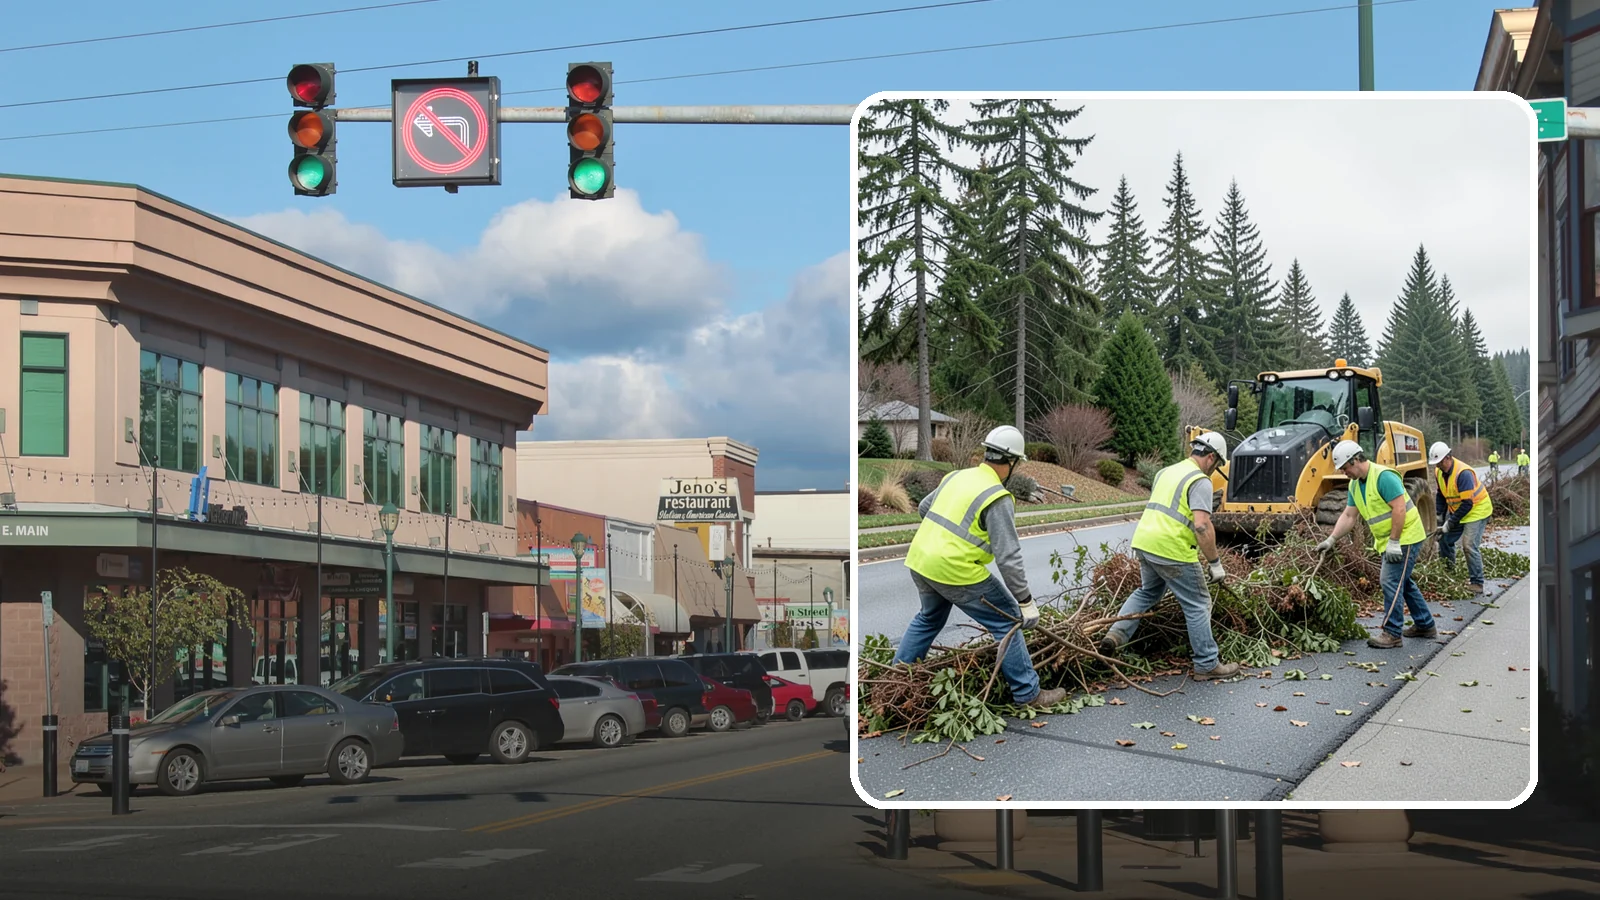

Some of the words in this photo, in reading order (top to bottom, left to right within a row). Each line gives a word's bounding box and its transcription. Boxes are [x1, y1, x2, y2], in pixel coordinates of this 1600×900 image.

[669, 480, 727, 494] Jeno's
[665, 496, 731, 509] restaurant
[658, 510, 682, 519] Italian
[686, 509, 715, 519] American
[715, 509, 738, 519] Cuisine
[2, 525, 13, 536] E.
[15, 525, 49, 536] MAIN
[797, 607, 828, 616] Street
